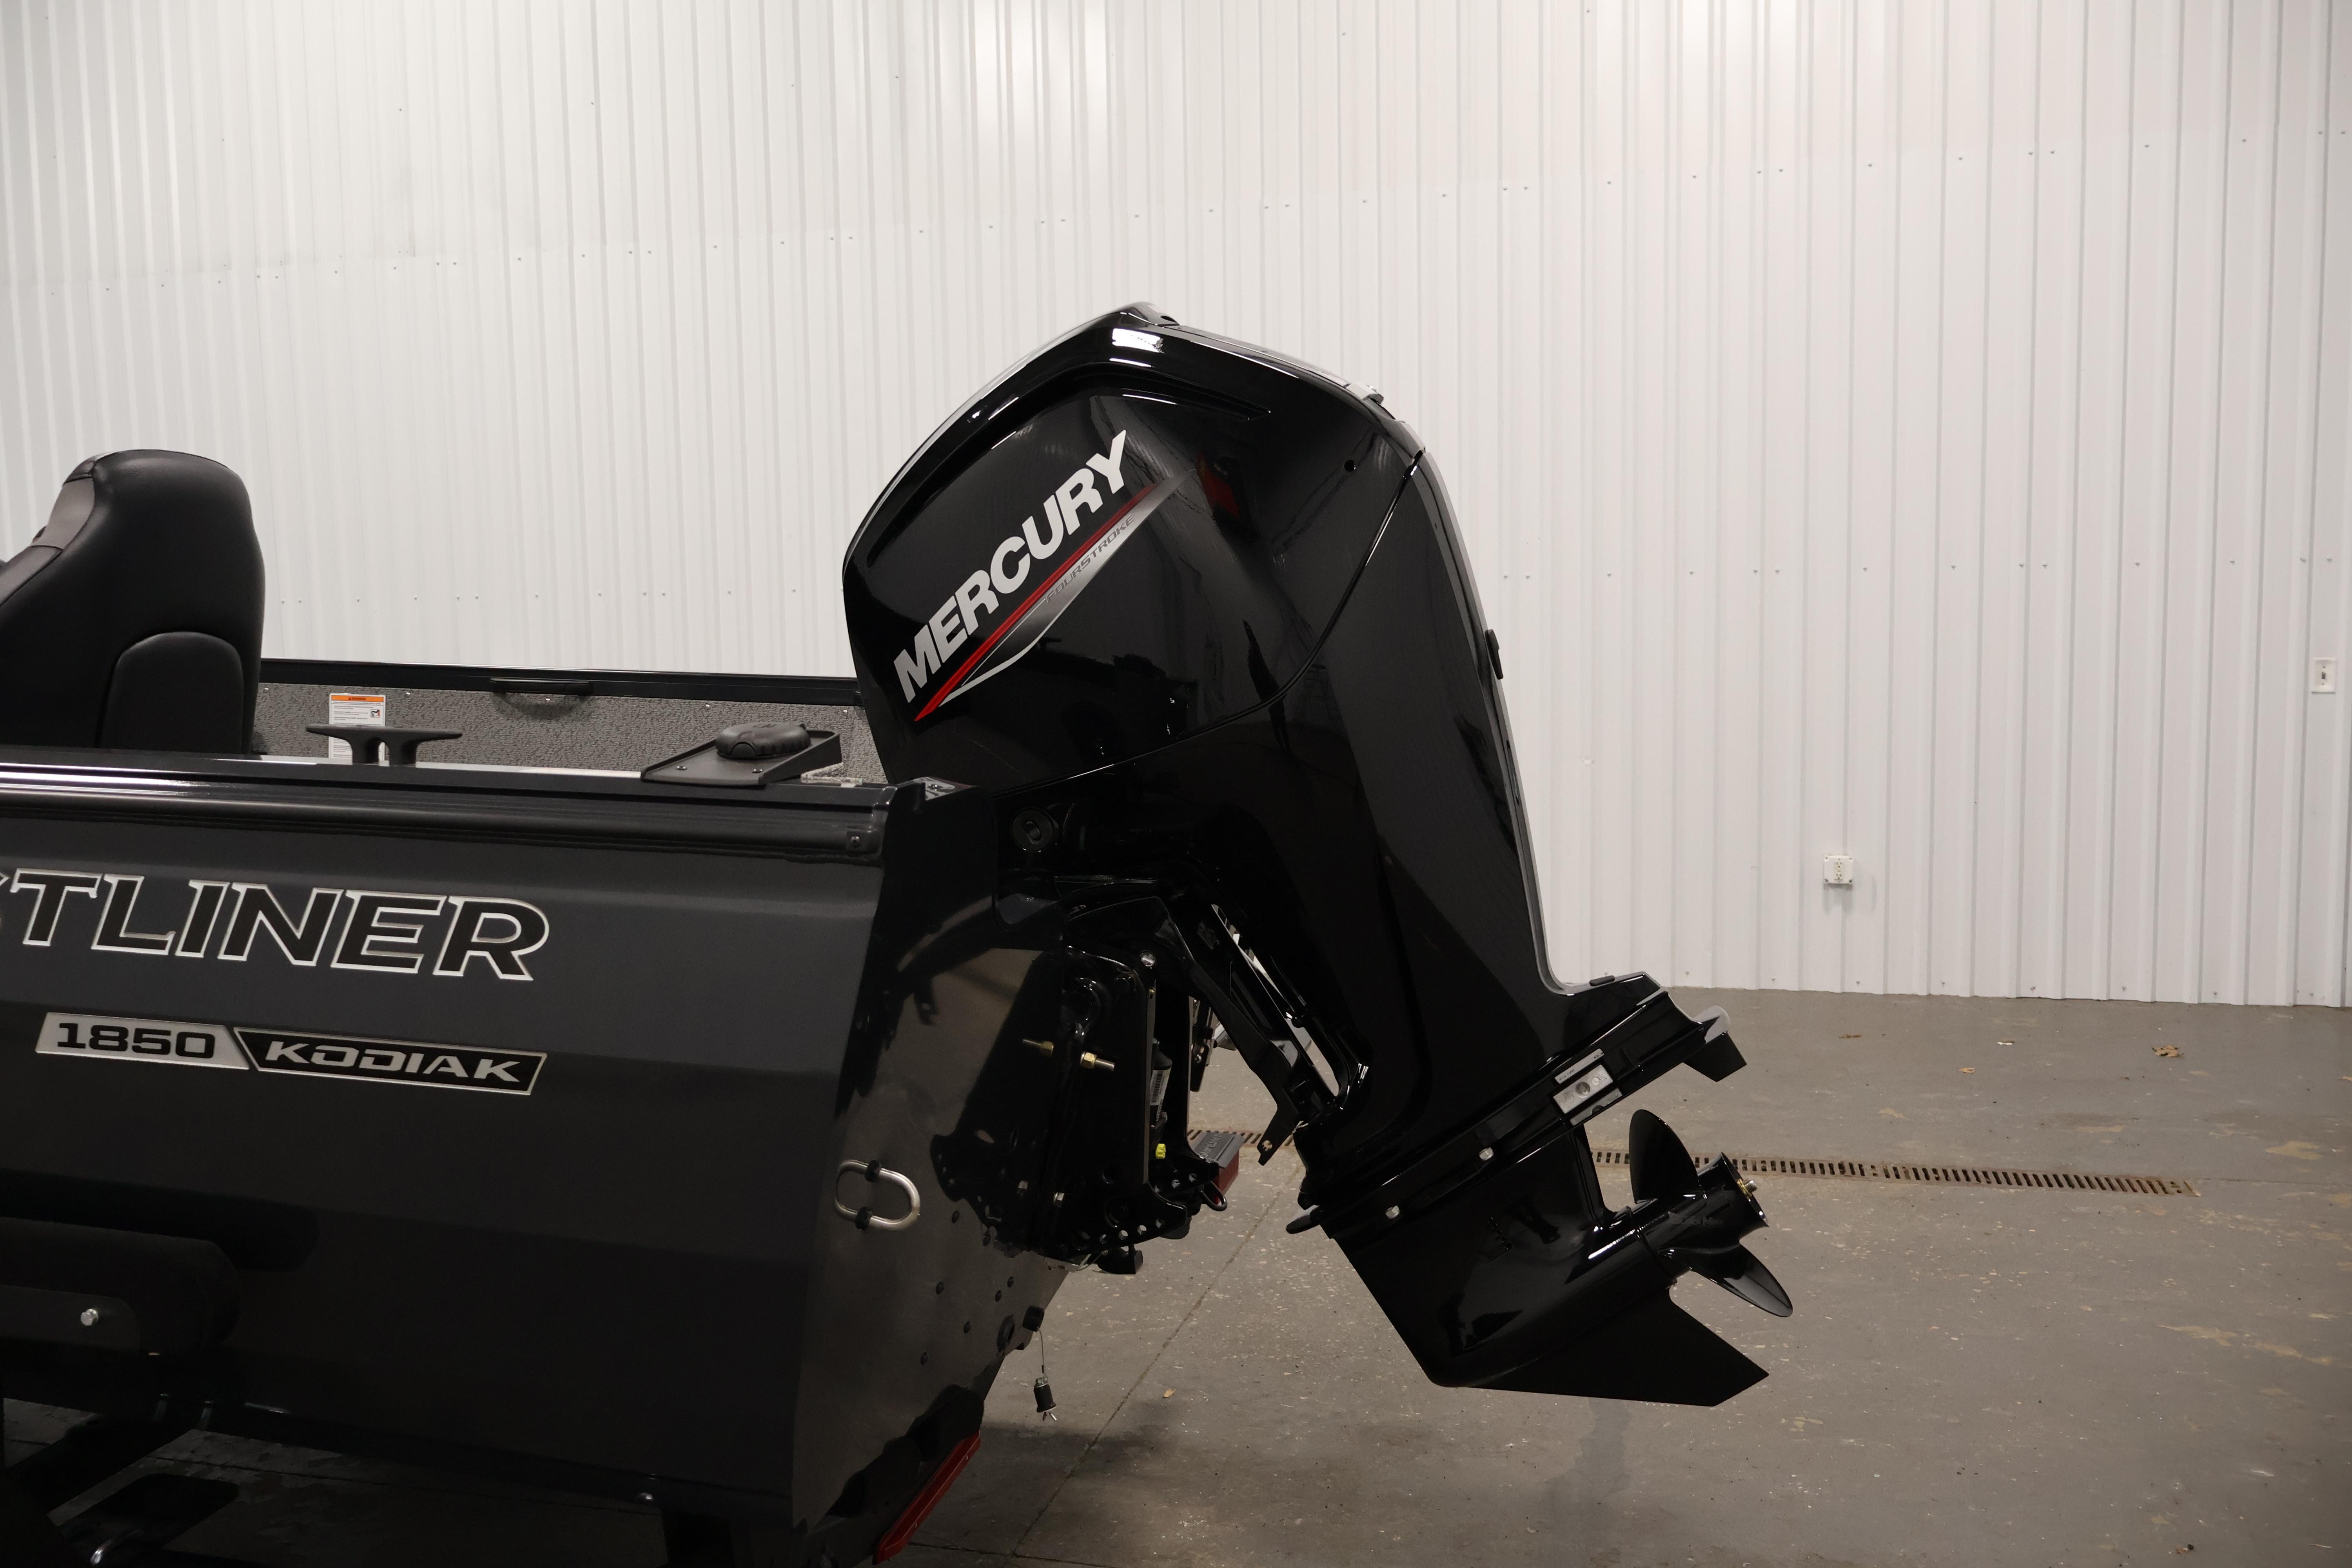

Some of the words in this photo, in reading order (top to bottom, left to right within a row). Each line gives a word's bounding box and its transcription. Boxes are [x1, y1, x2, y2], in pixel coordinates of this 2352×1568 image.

[893, 430, 1127, 703] MERCURY
[1045, 514, 1134, 603] FOURSTROKE
[0, 868, 550, 981] TLINER
[57, 1023, 216, 1059] 1850
[265, 1041, 520, 1082] KODIAK
